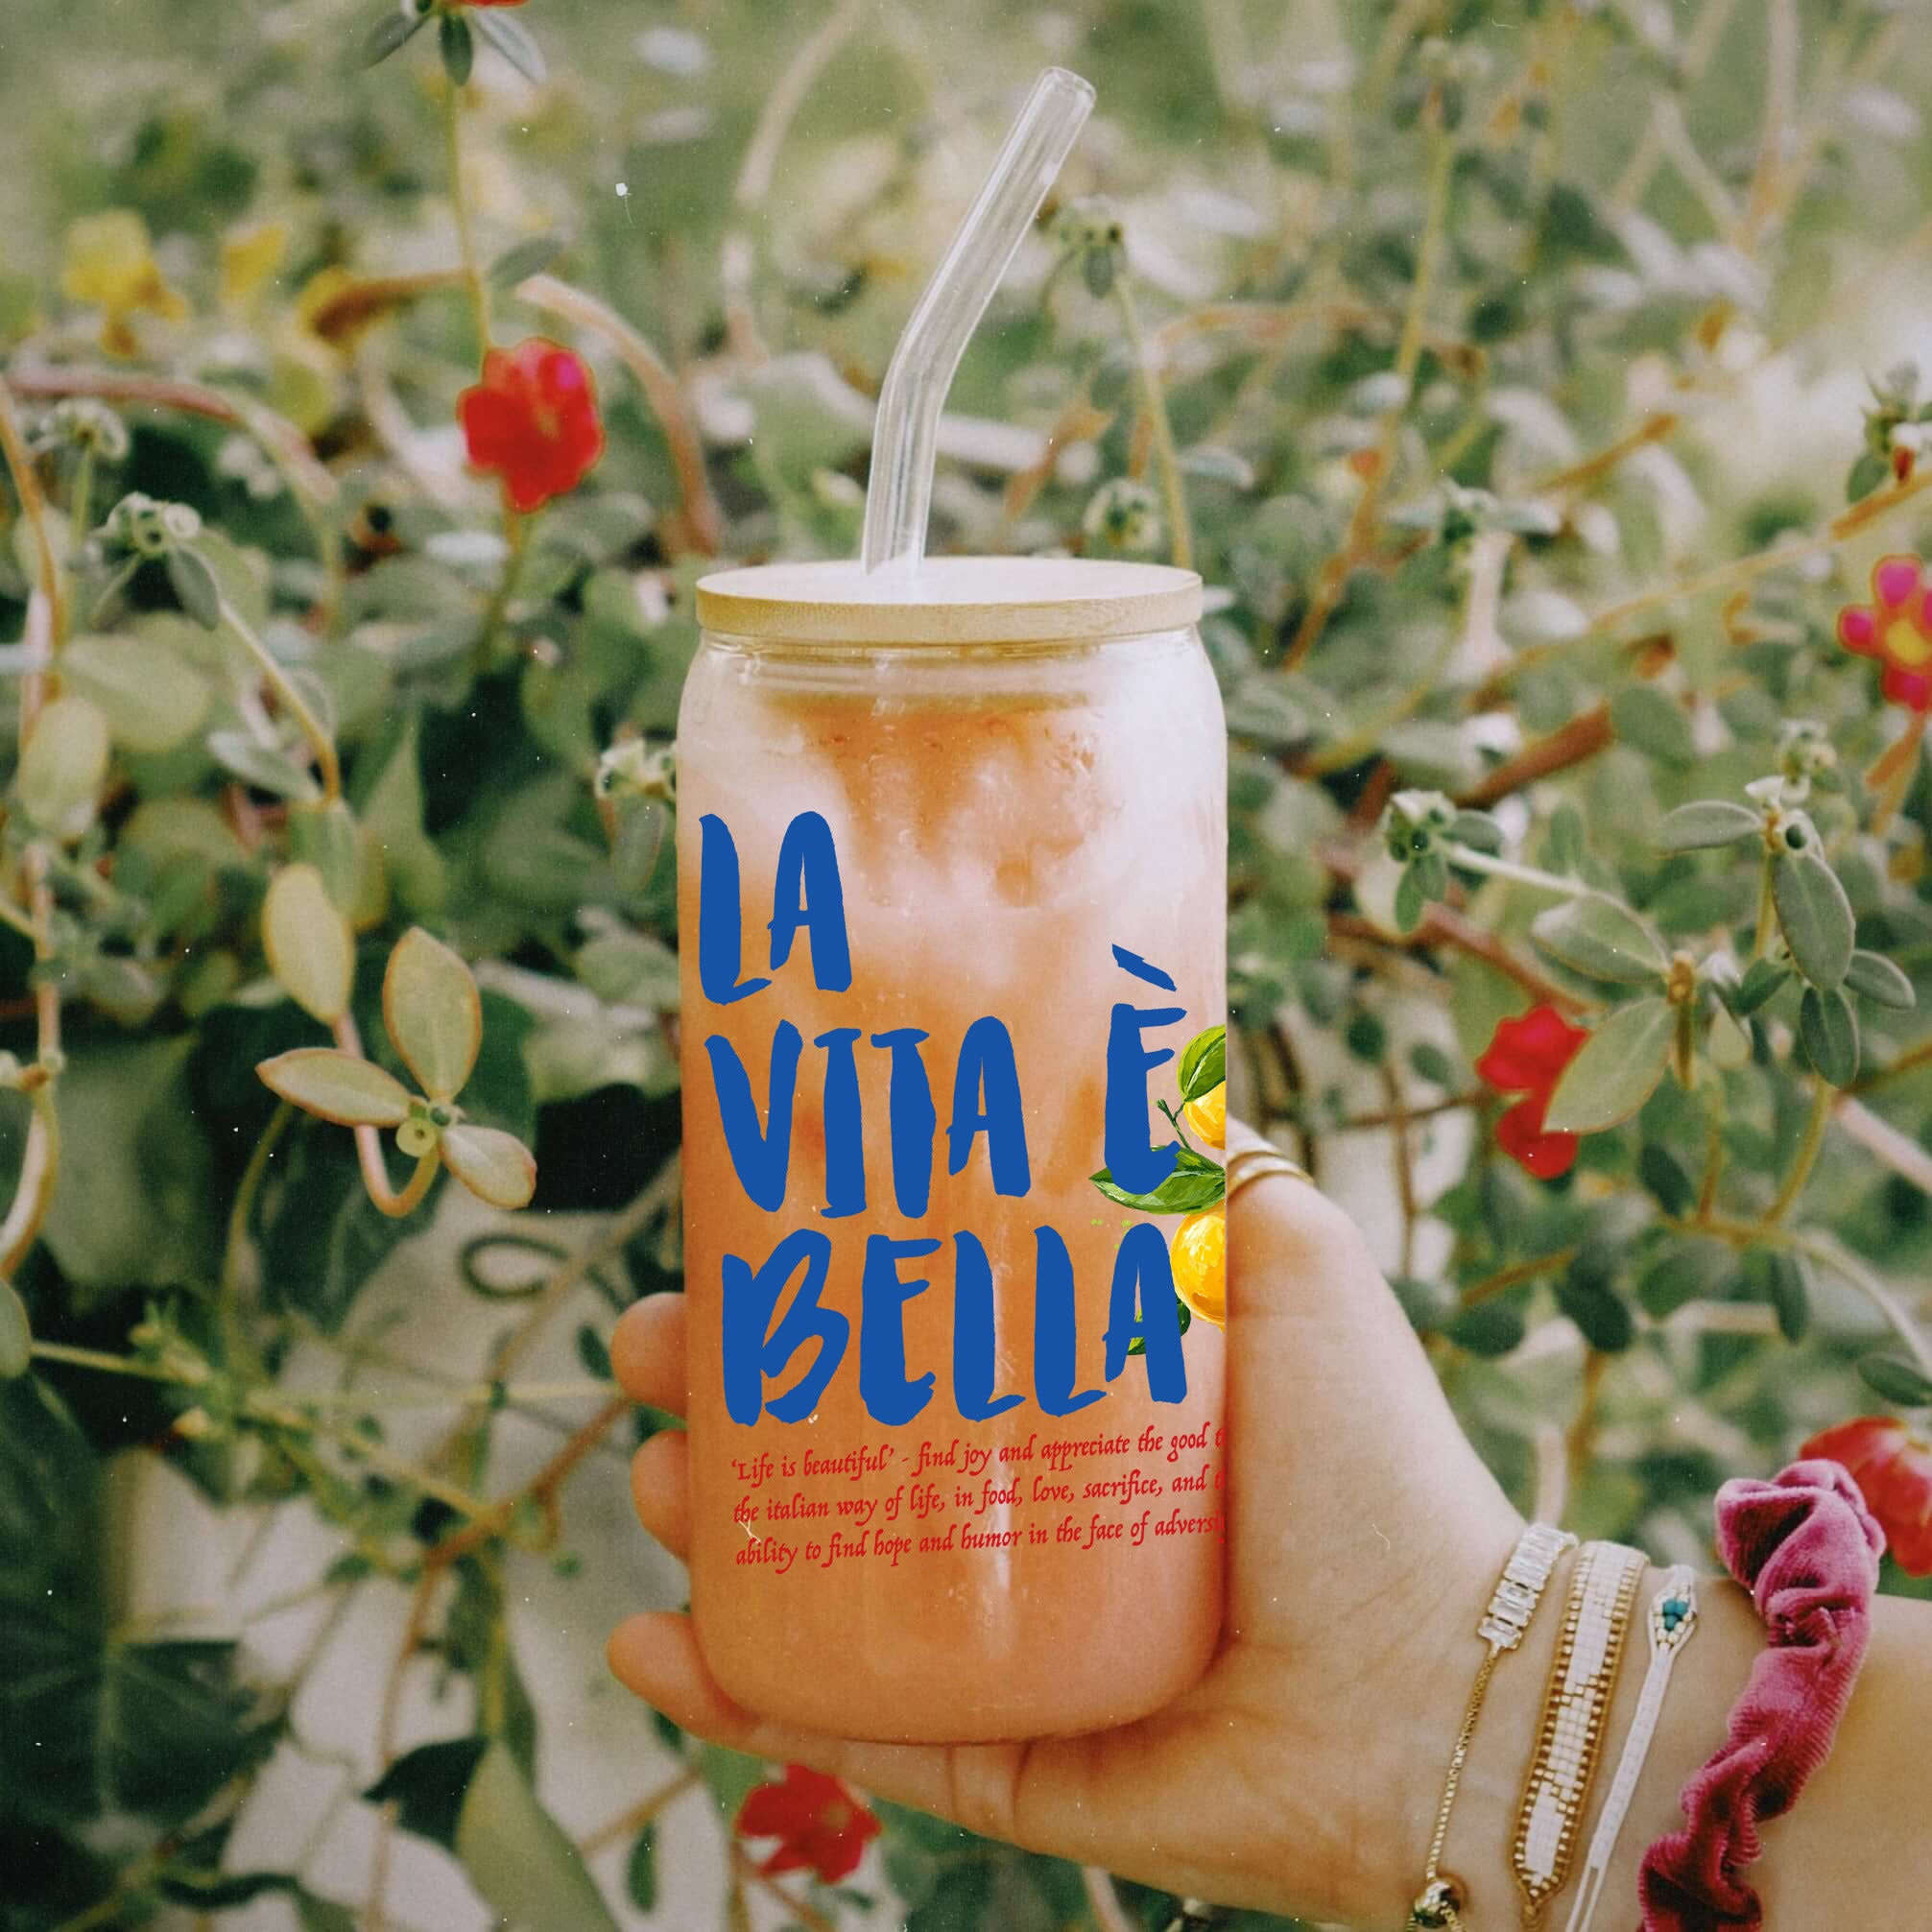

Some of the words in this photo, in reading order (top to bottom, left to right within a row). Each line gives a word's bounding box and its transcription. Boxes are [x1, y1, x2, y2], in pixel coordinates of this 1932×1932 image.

[699, 811, 853, 1006] LA
[704, 1015, 1032, 1220] VITA
[1103, 943, 1188, 1196] È
[721, 1223, 1188, 1427] BELLA
[732, 1494, 759, 1524] the
[767, 1491, 831, 1522] italian
[836, 1497, 879, 1528] way
[884, 1485, 905, 1522] of
[909, 1481, 947, 1519] life,
[954, 1485, 974, 1509] in
[973, 1478, 1023, 1515] food,
[1033, 1474, 1076, 1505] love,
[1082, 1468, 1164, 1506] sacrifice,
[1171, 1463, 1211, 1493] and
[780, 1455, 798, 1478] is
[910, 1438, 961, 1478] find
[956, 1443, 992, 1477] joy
[998, 1433, 1038, 1464] and
[1040, 1433, 1132, 1472] appreciate
[1137, 1424, 1164, 1453] the
[1166, 1420, 1211, 1464] good
[735, 1536, 799, 1576] ability
[804, 1539, 823, 1562] to
[821, 1529, 871, 1569] find
[873, 1528, 913, 1568] hope
[918, 1523, 959, 1553] and
[961, 1521, 1023, 1551] humor
[1028, 1522, 1049, 1545] in
[1056, 1515, 1083, 1543] the
[1081, 1513, 1125, 1551] face
[1130, 1510, 1152, 1547] of
